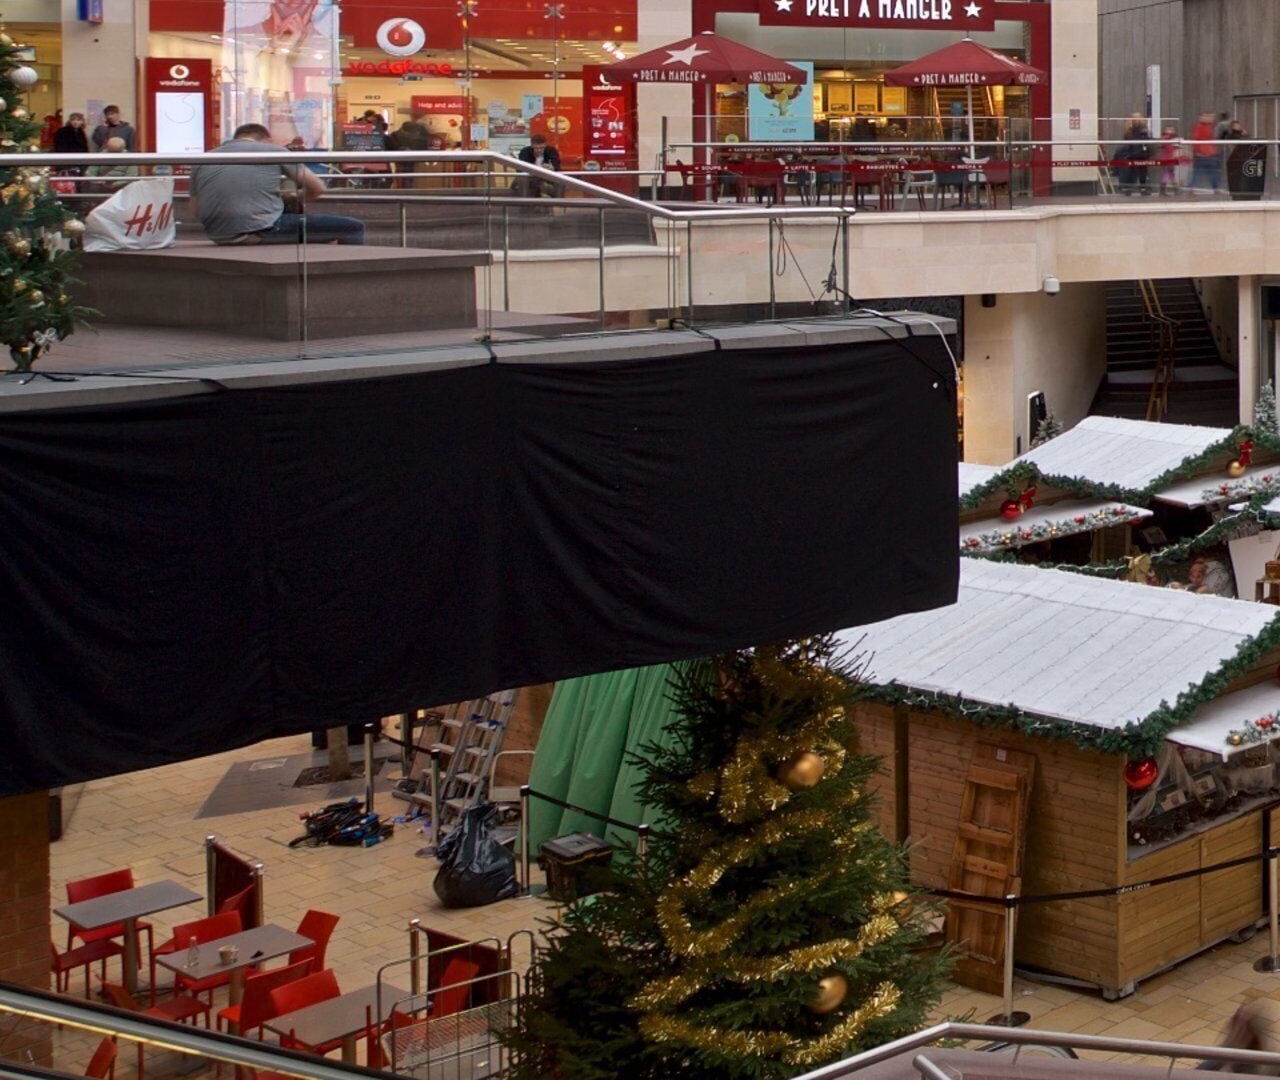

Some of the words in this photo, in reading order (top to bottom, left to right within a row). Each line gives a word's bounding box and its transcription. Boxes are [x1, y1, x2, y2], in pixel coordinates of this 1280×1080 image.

[349, 59, 452, 74] vodafone
[641, 70, 658, 81] PRET
[661, 70, 667, 81] A
[669, 70, 699, 81] MANGER
[921, 74, 939, 84] PRET
[941, 74, 946, 83] A
[949, 73, 979, 83] MANGER
[124, 202, 174, 237] H&M
